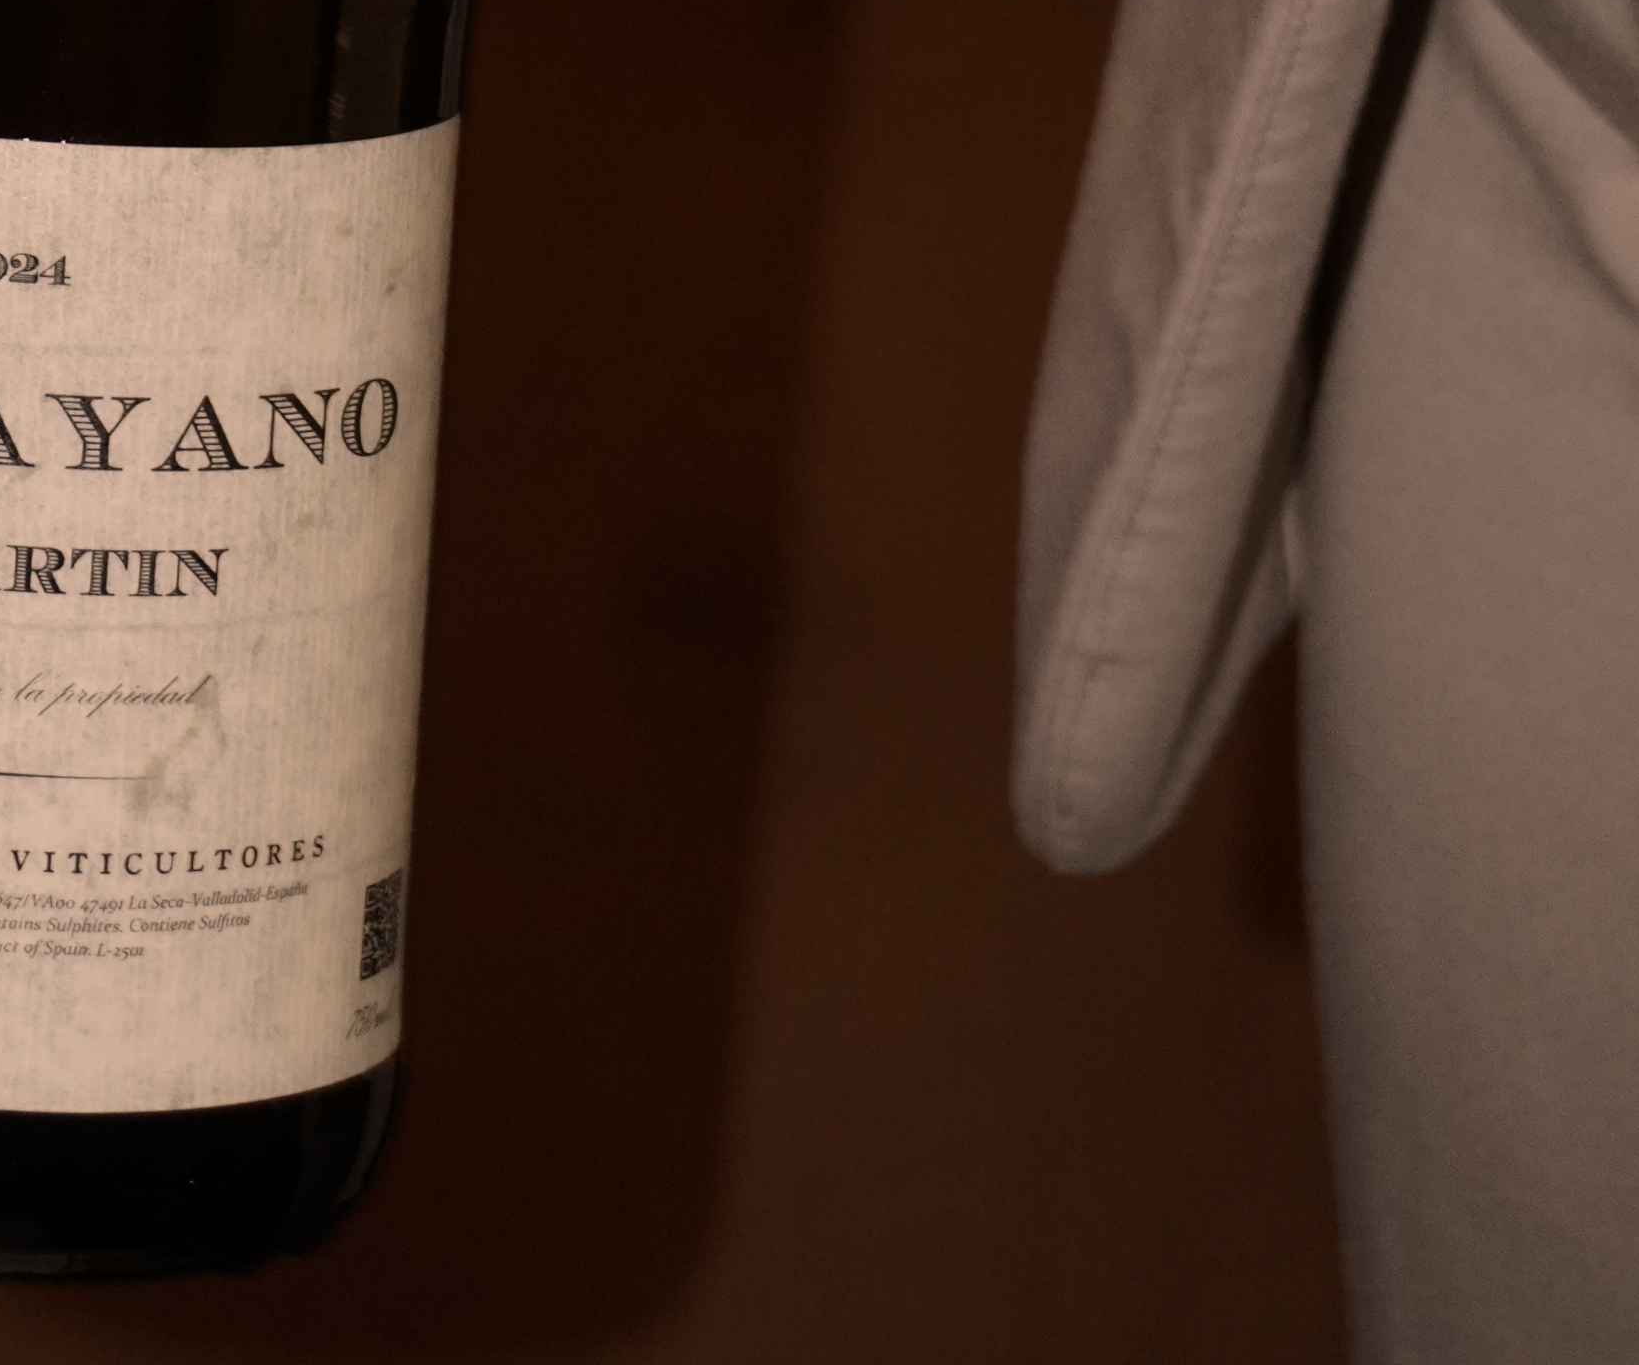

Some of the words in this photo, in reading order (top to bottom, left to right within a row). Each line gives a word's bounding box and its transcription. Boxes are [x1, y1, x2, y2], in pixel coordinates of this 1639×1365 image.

[14, 668, 52, 701] la
[38, 674, 212, 718] propiedad
[10, 834, 325, 876] VITICULTORES
[79, 898, 124, 914] 47491
[128, 894, 148, 910] La
[45, 916, 123, 937] Sulphites.
[128, 914, 196, 934] Contiene
[198, 912, 251, 933] Sulfitos
[23, 939, 43, 959] of
[42, 940, 92, 960] Spain.
